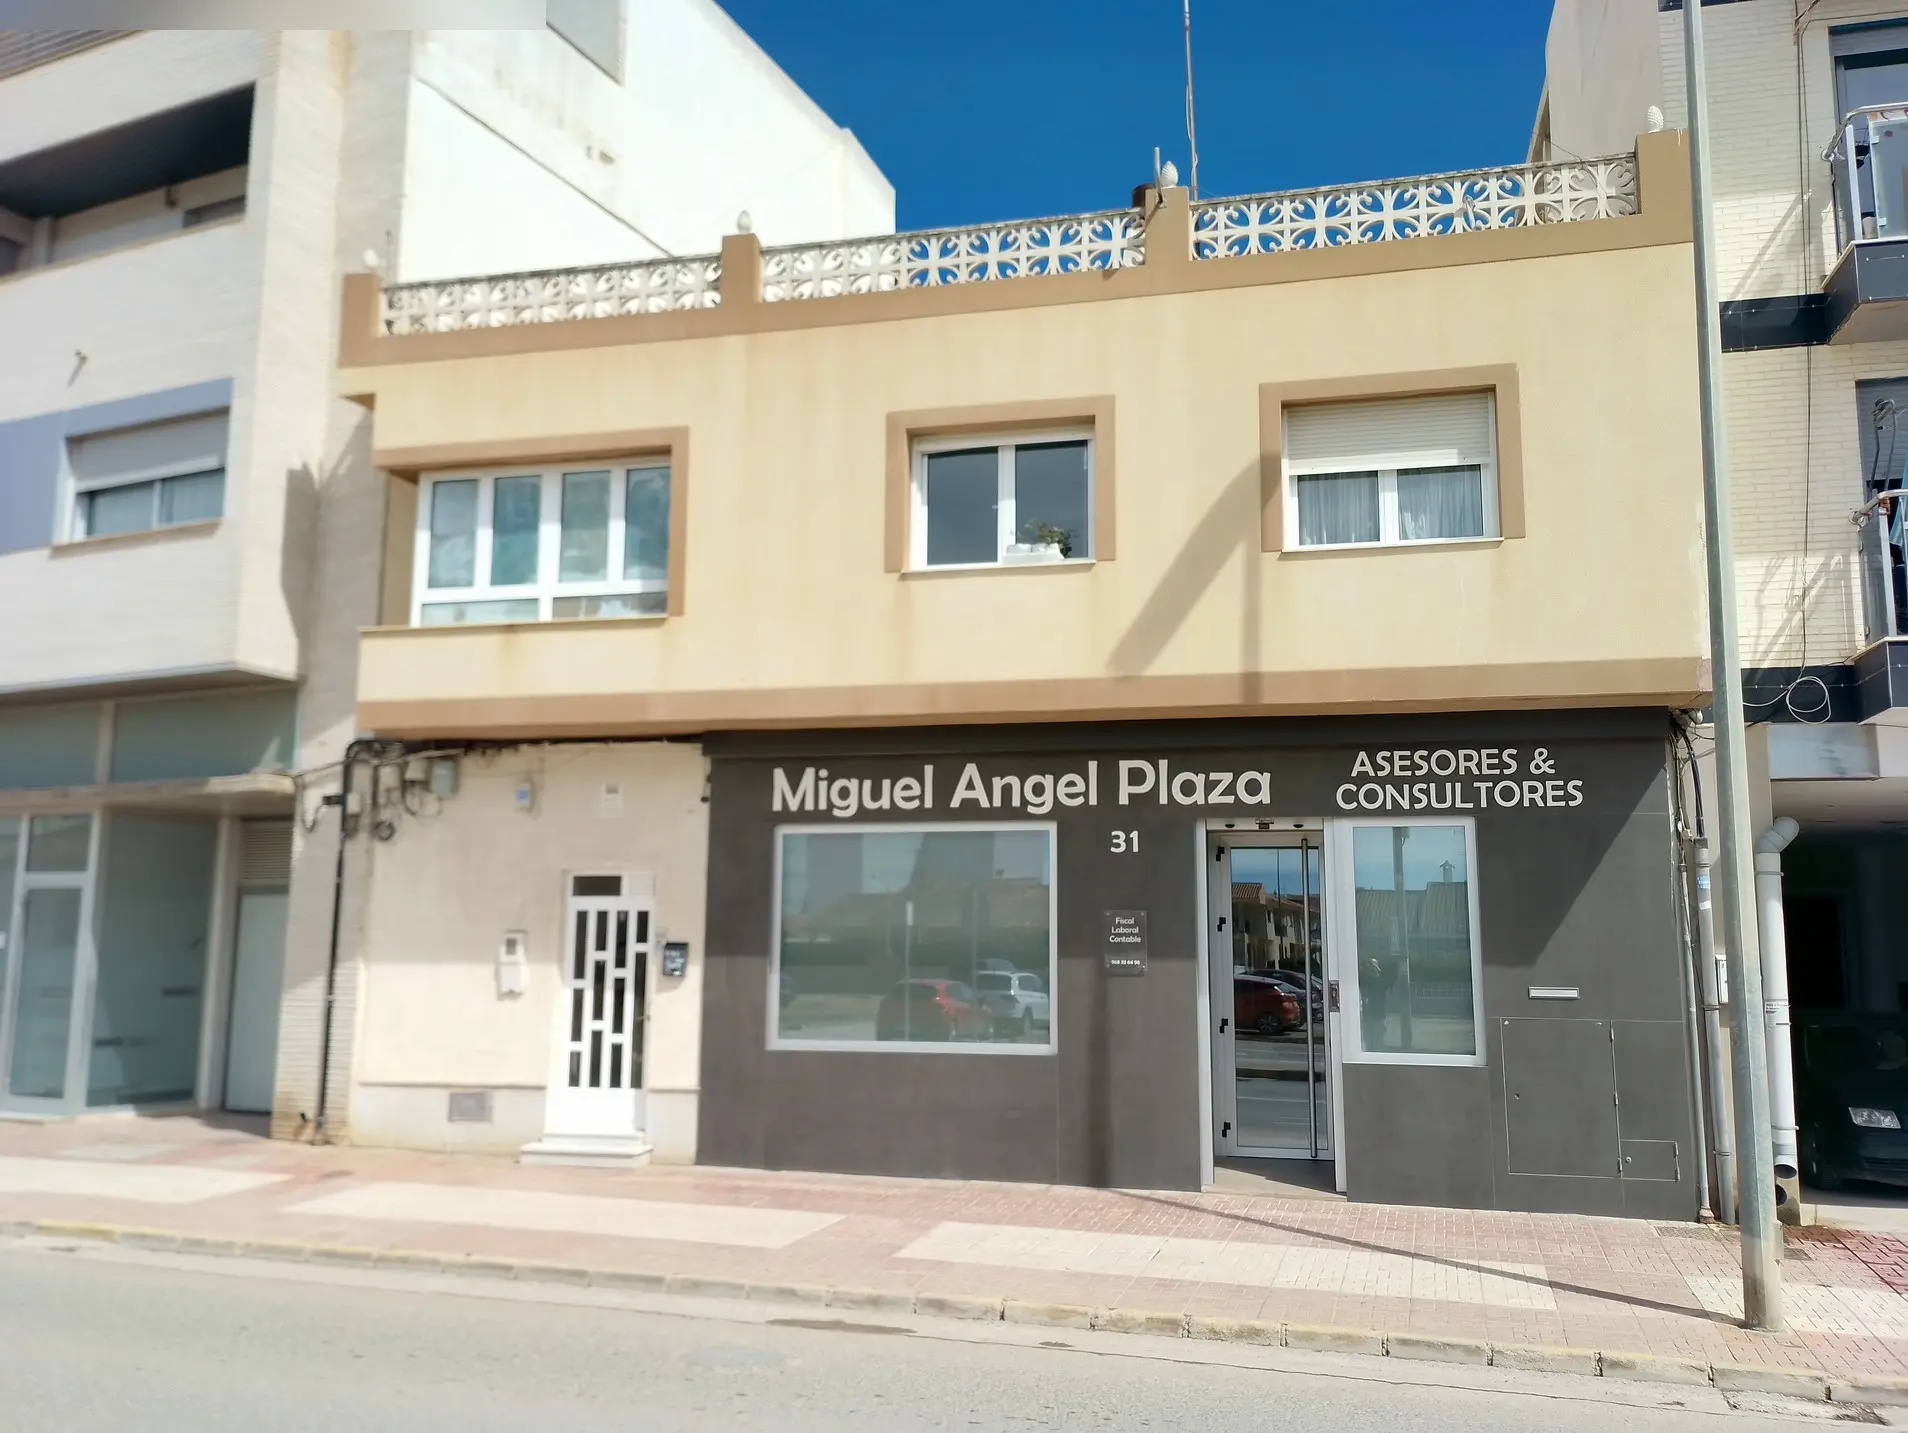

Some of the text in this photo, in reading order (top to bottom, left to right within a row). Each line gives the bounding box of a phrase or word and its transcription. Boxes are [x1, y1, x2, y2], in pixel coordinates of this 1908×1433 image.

[1350, 747, 1556, 777] ASESORES &
[772, 759, 1271, 818] Miguel Angel Plaza
[1336, 779, 1583, 810] CONSULTORES
[1110, 830, 1139, 853] 31
[1111, 926, 1139, 934] Laboral
[1115, 917, 1135, 925] Fiscal
[1109, 935, 1142, 943] Contable
